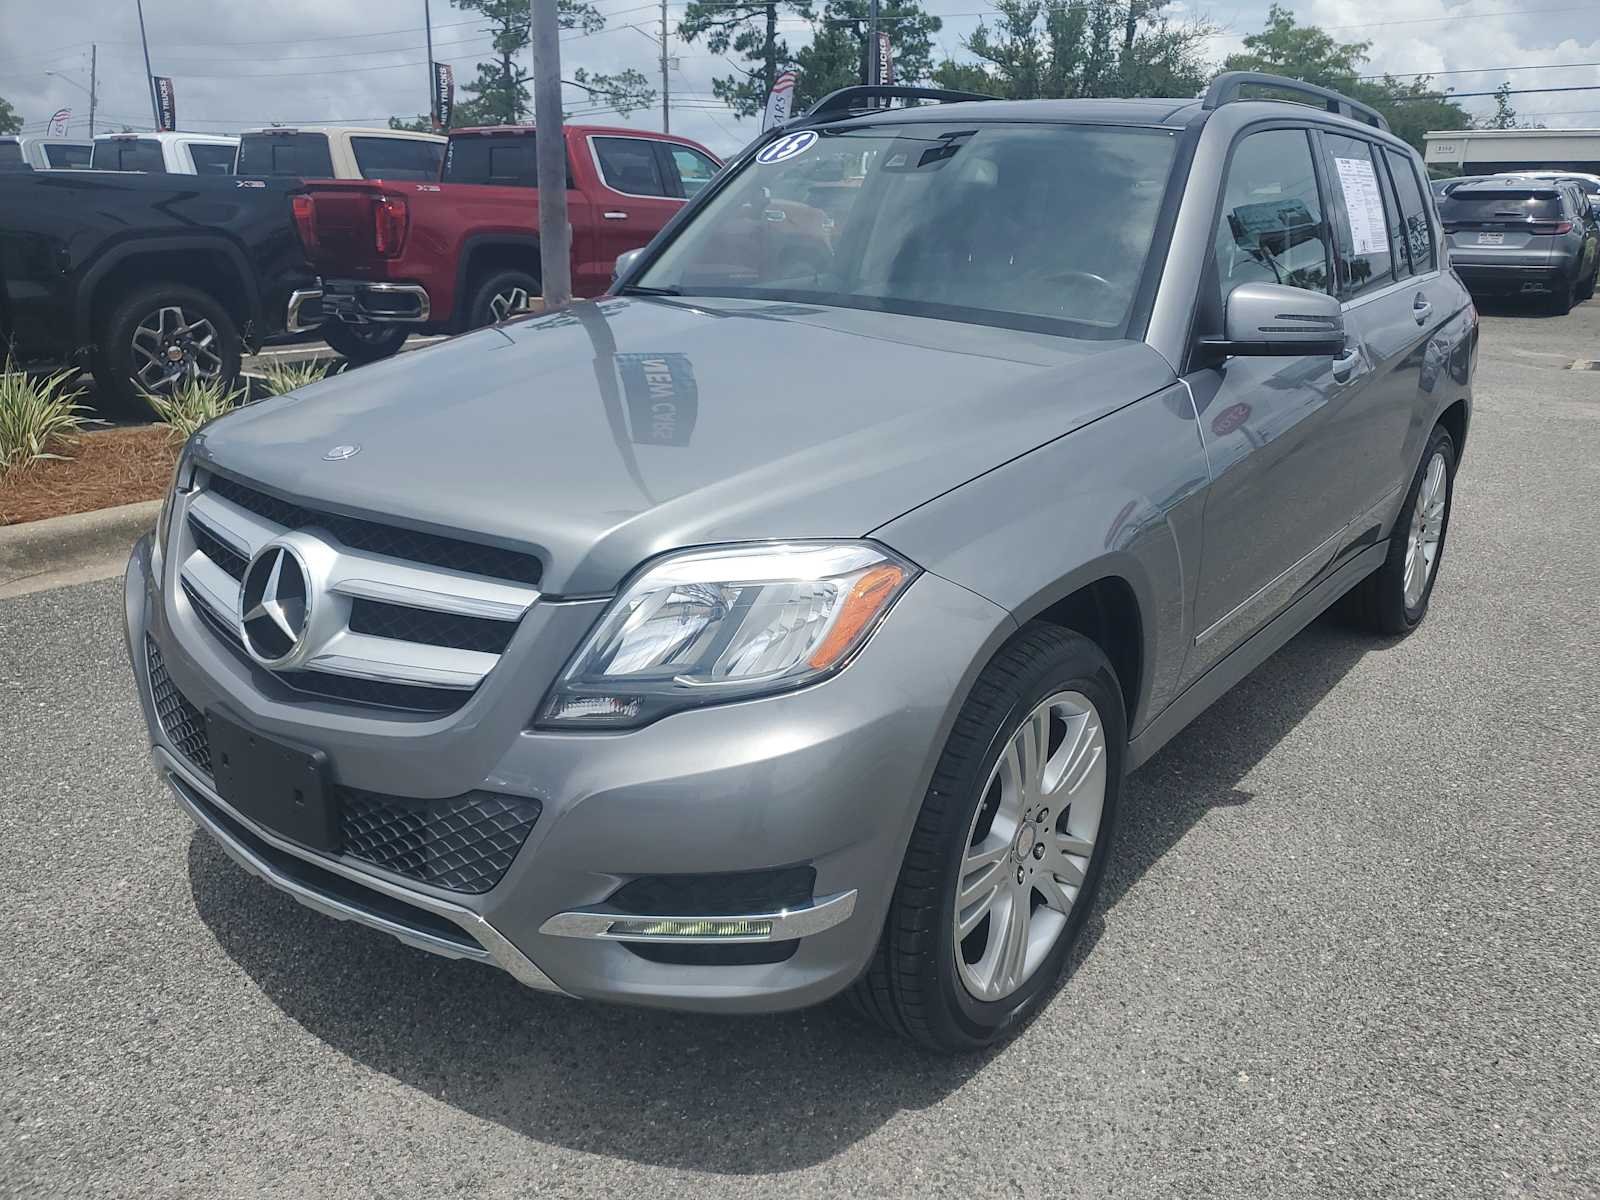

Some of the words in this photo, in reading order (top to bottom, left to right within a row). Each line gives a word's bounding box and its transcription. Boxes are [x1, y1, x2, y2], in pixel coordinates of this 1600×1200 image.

[439, 67, 449, 103] TRUCKS
[773, 95, 786, 125] ARS
[762, 133, 813, 161] 15
